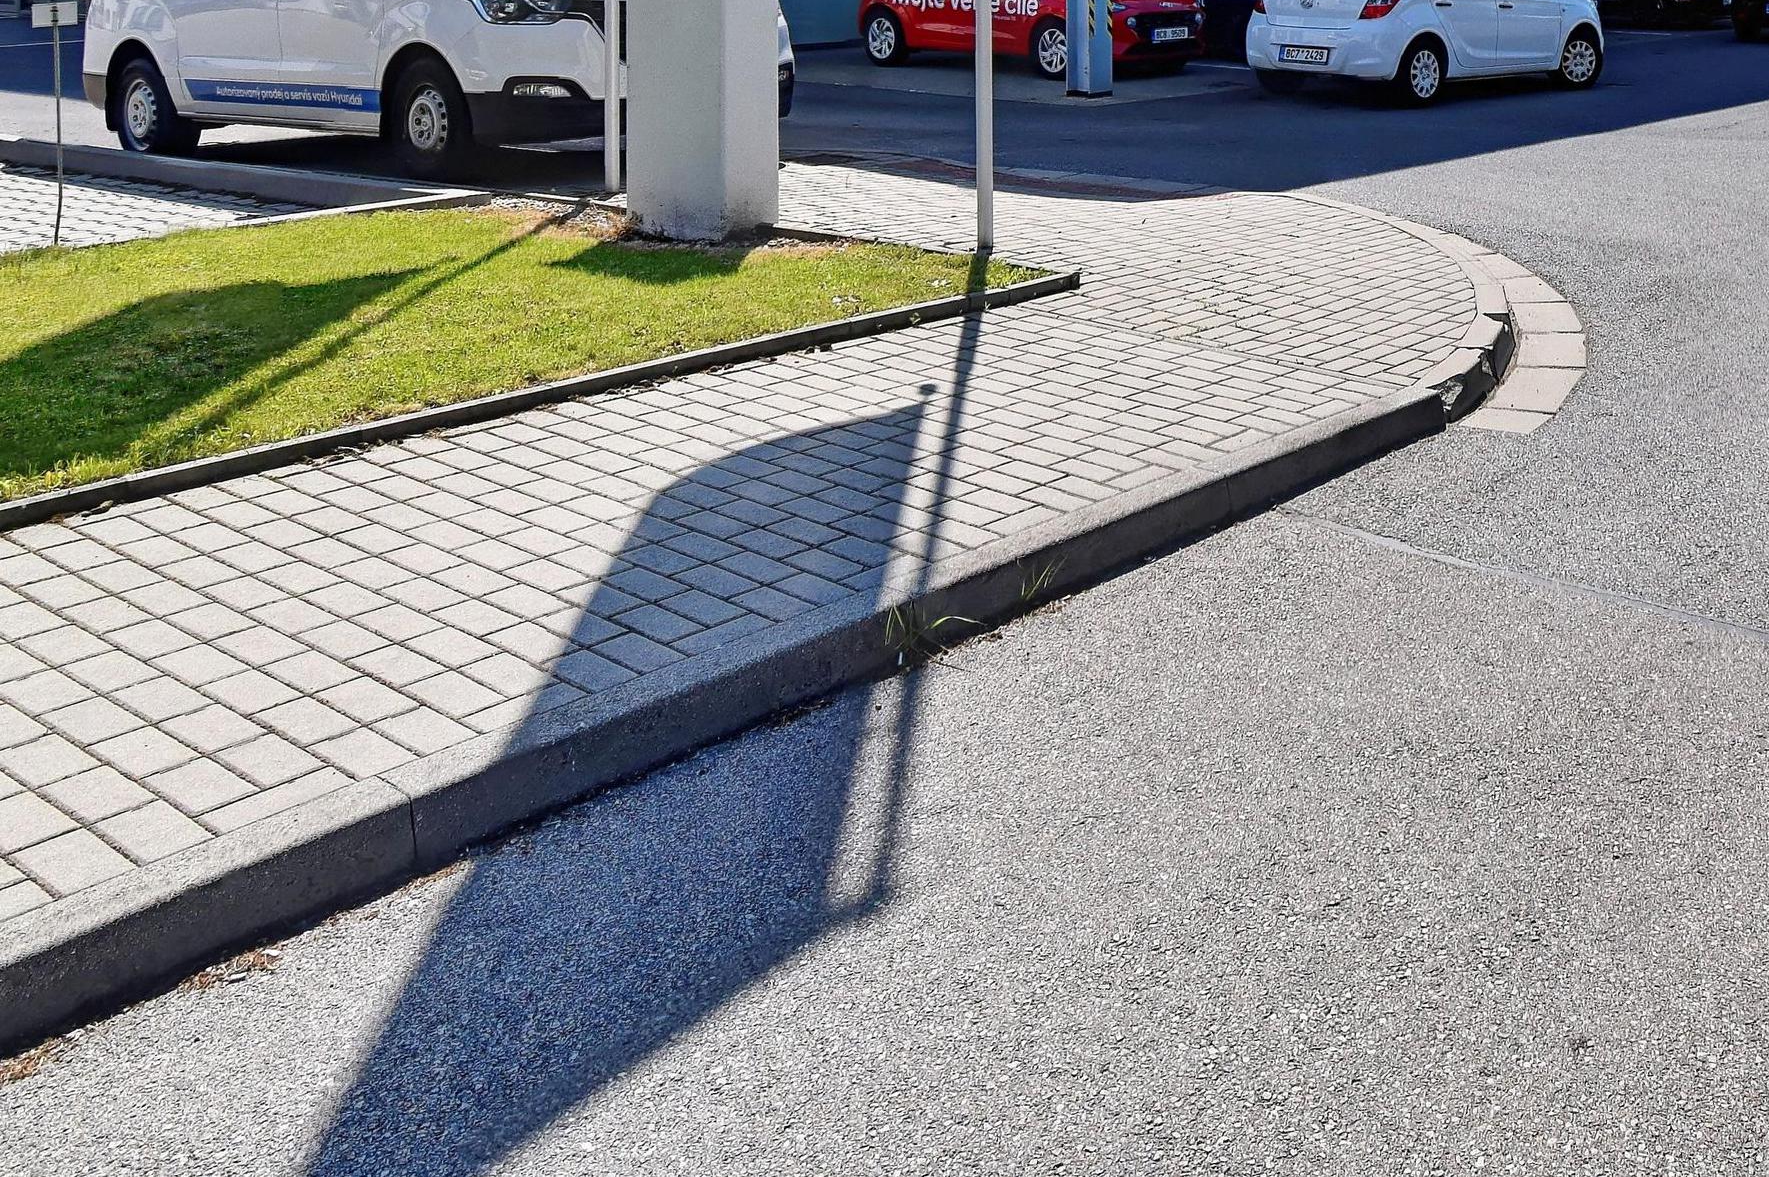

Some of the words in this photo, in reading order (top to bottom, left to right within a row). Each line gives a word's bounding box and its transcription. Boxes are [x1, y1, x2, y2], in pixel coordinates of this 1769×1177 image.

[1304, 48, 1325, 61] 2429
[216, 86, 260, 100] Autorizovaný
[260, 89, 284, 100] prodej
[290, 90, 312, 100] servis
[312, 90, 330, 102] vozů
[330, 92, 363, 107] Hyundai
